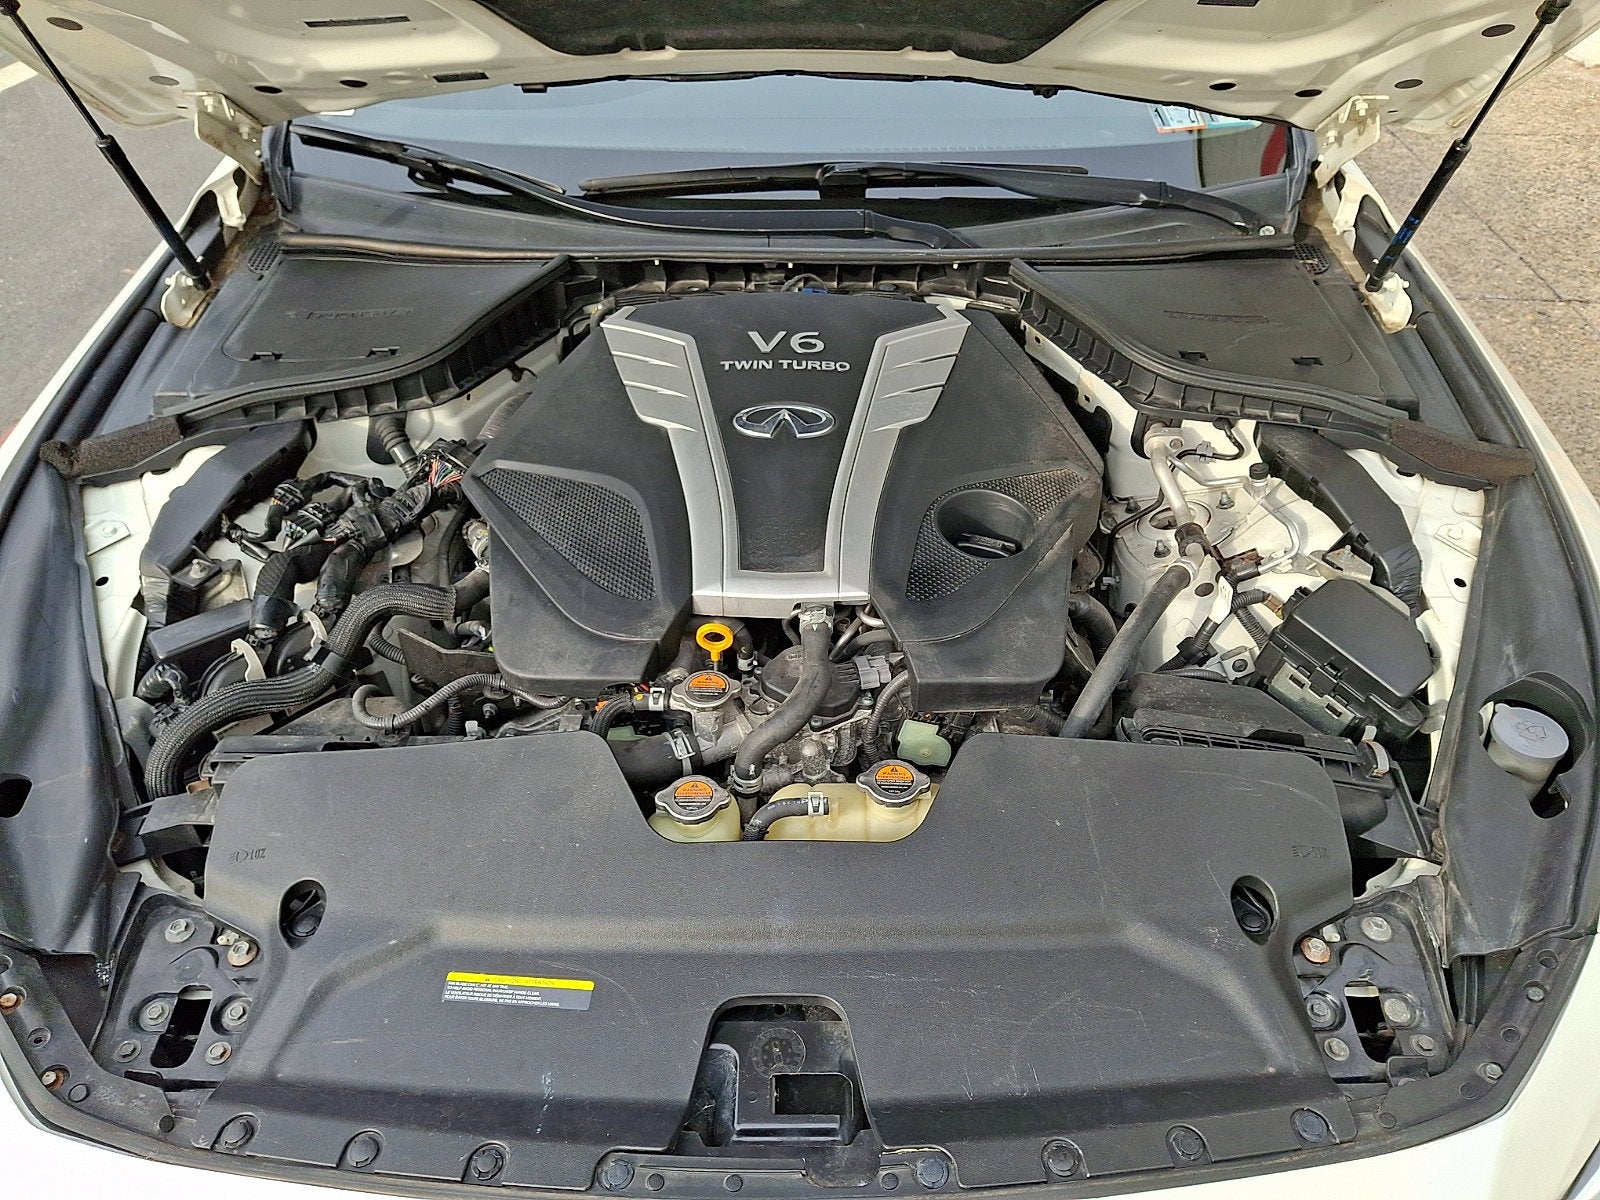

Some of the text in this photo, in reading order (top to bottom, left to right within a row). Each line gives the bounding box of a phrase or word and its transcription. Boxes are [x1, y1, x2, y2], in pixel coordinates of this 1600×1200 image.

[747, 331, 825, 354] V6
[720, 359, 851, 372] TWIN TURBO
